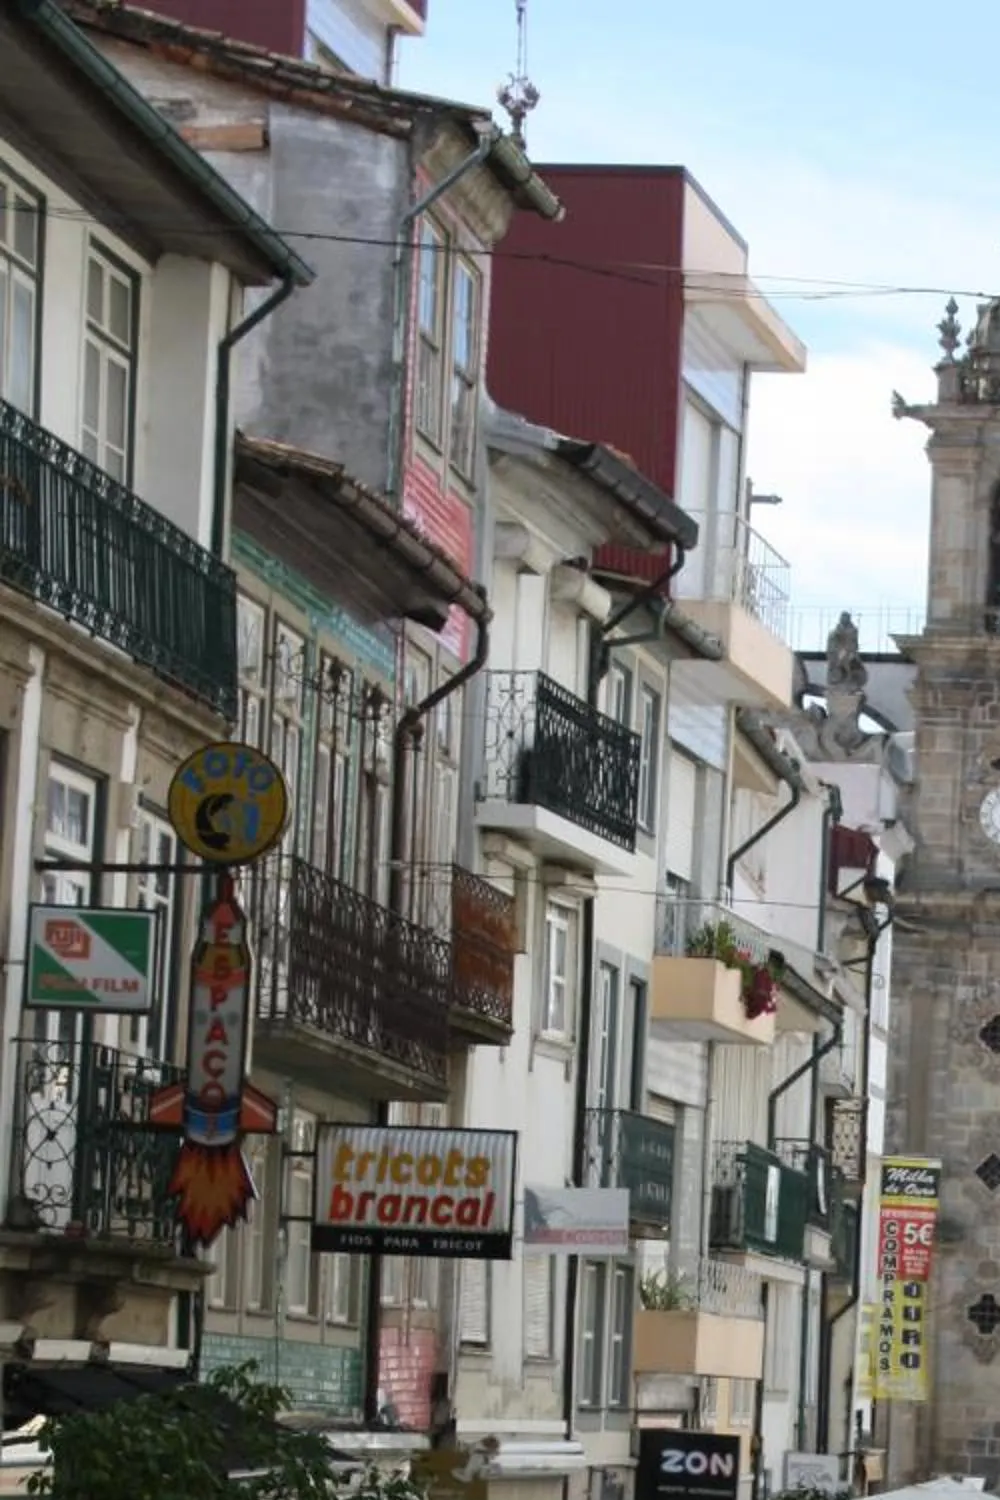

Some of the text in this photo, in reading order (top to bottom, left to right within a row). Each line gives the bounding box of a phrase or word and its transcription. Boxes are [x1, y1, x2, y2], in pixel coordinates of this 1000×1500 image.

[182, 751, 273, 794] FOTO
[91, 977, 140, 993] FILM
[334, 1142, 491, 1188] tricots
[329, 1184, 496, 1228] brancal
[340, 1234, 483, 1251] FIOS PARA TRICOT
[903, 1223, 935, 1246] 5€
[660, 1449, 733, 1478] ZON
